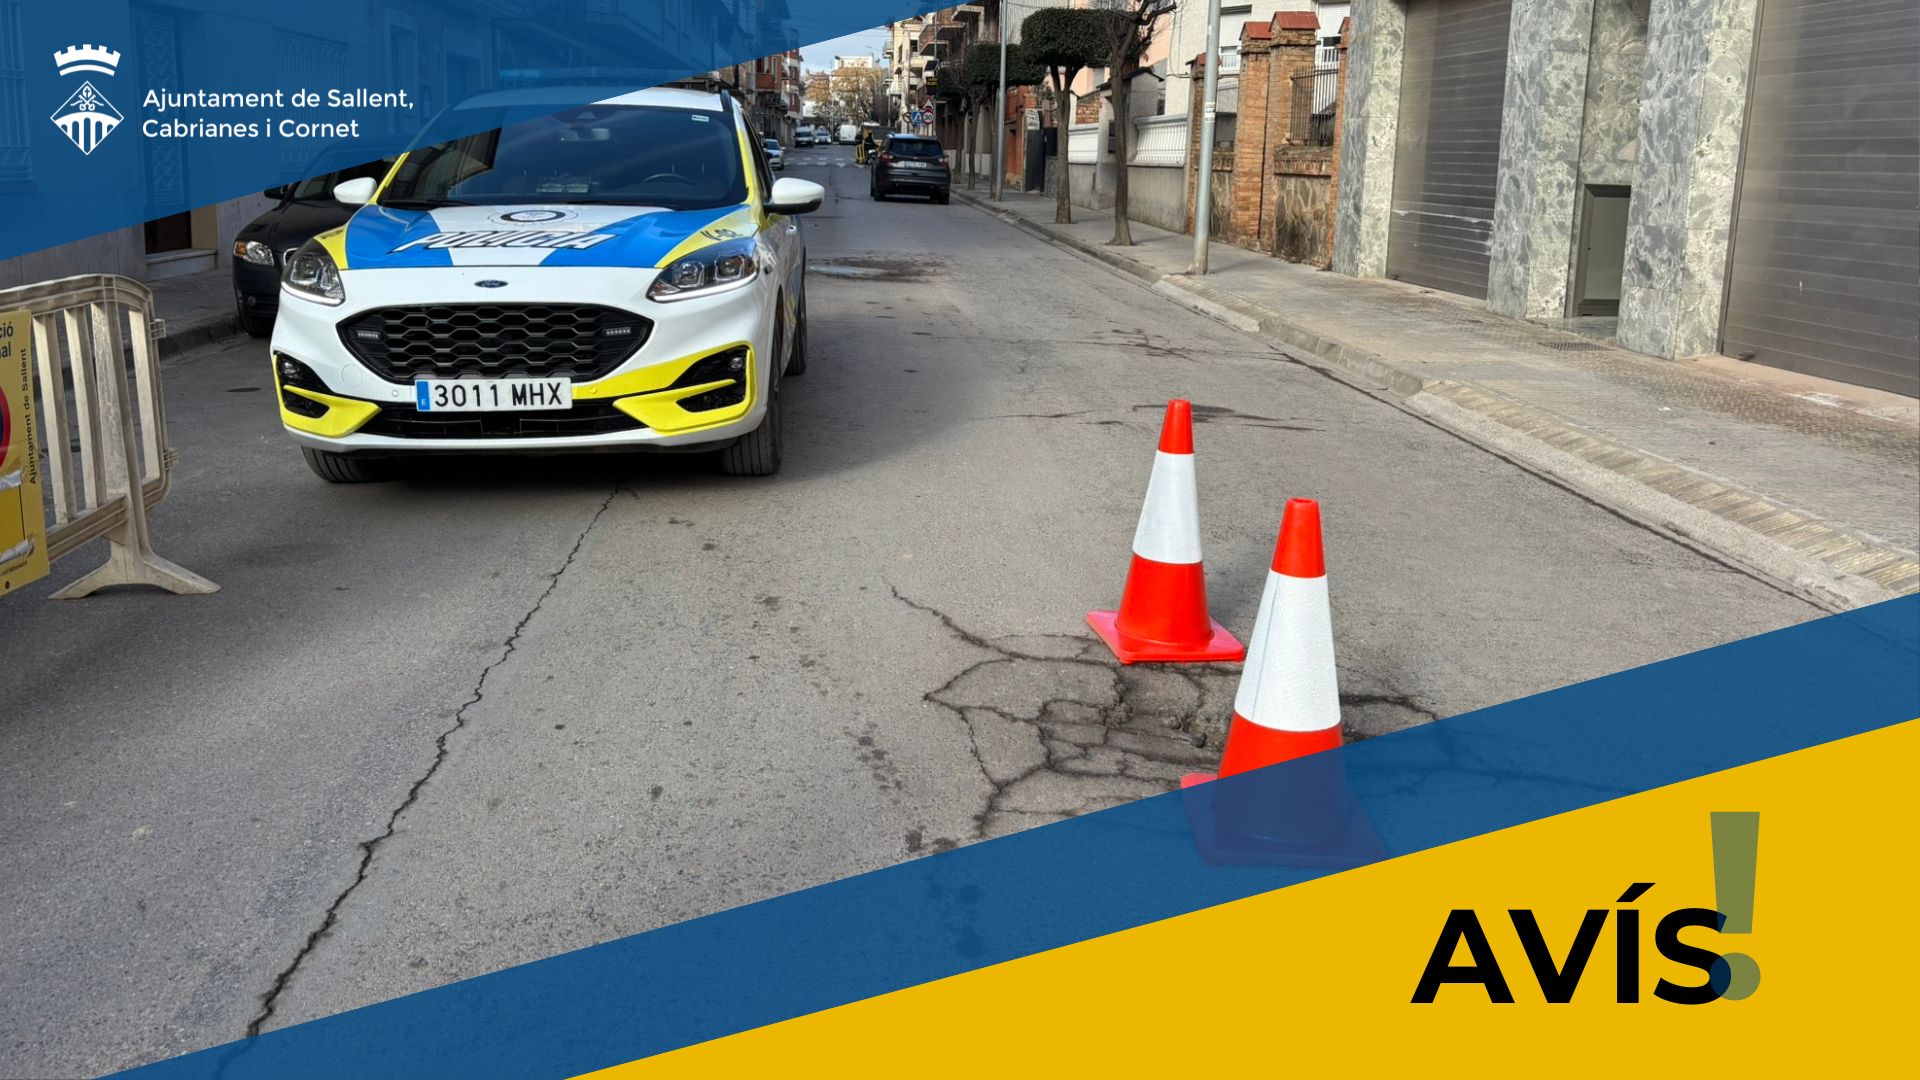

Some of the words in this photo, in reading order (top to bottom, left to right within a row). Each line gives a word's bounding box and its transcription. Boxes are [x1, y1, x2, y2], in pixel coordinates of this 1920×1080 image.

[0, 341, 11, 358] al
[20, 348, 29, 391] Sallent
[23, 395, 30, 411] de
[434, 383, 499, 407] 3011
[511, 382, 562, 406] MHX
[24, 413, 37, 484] Ajuntament
